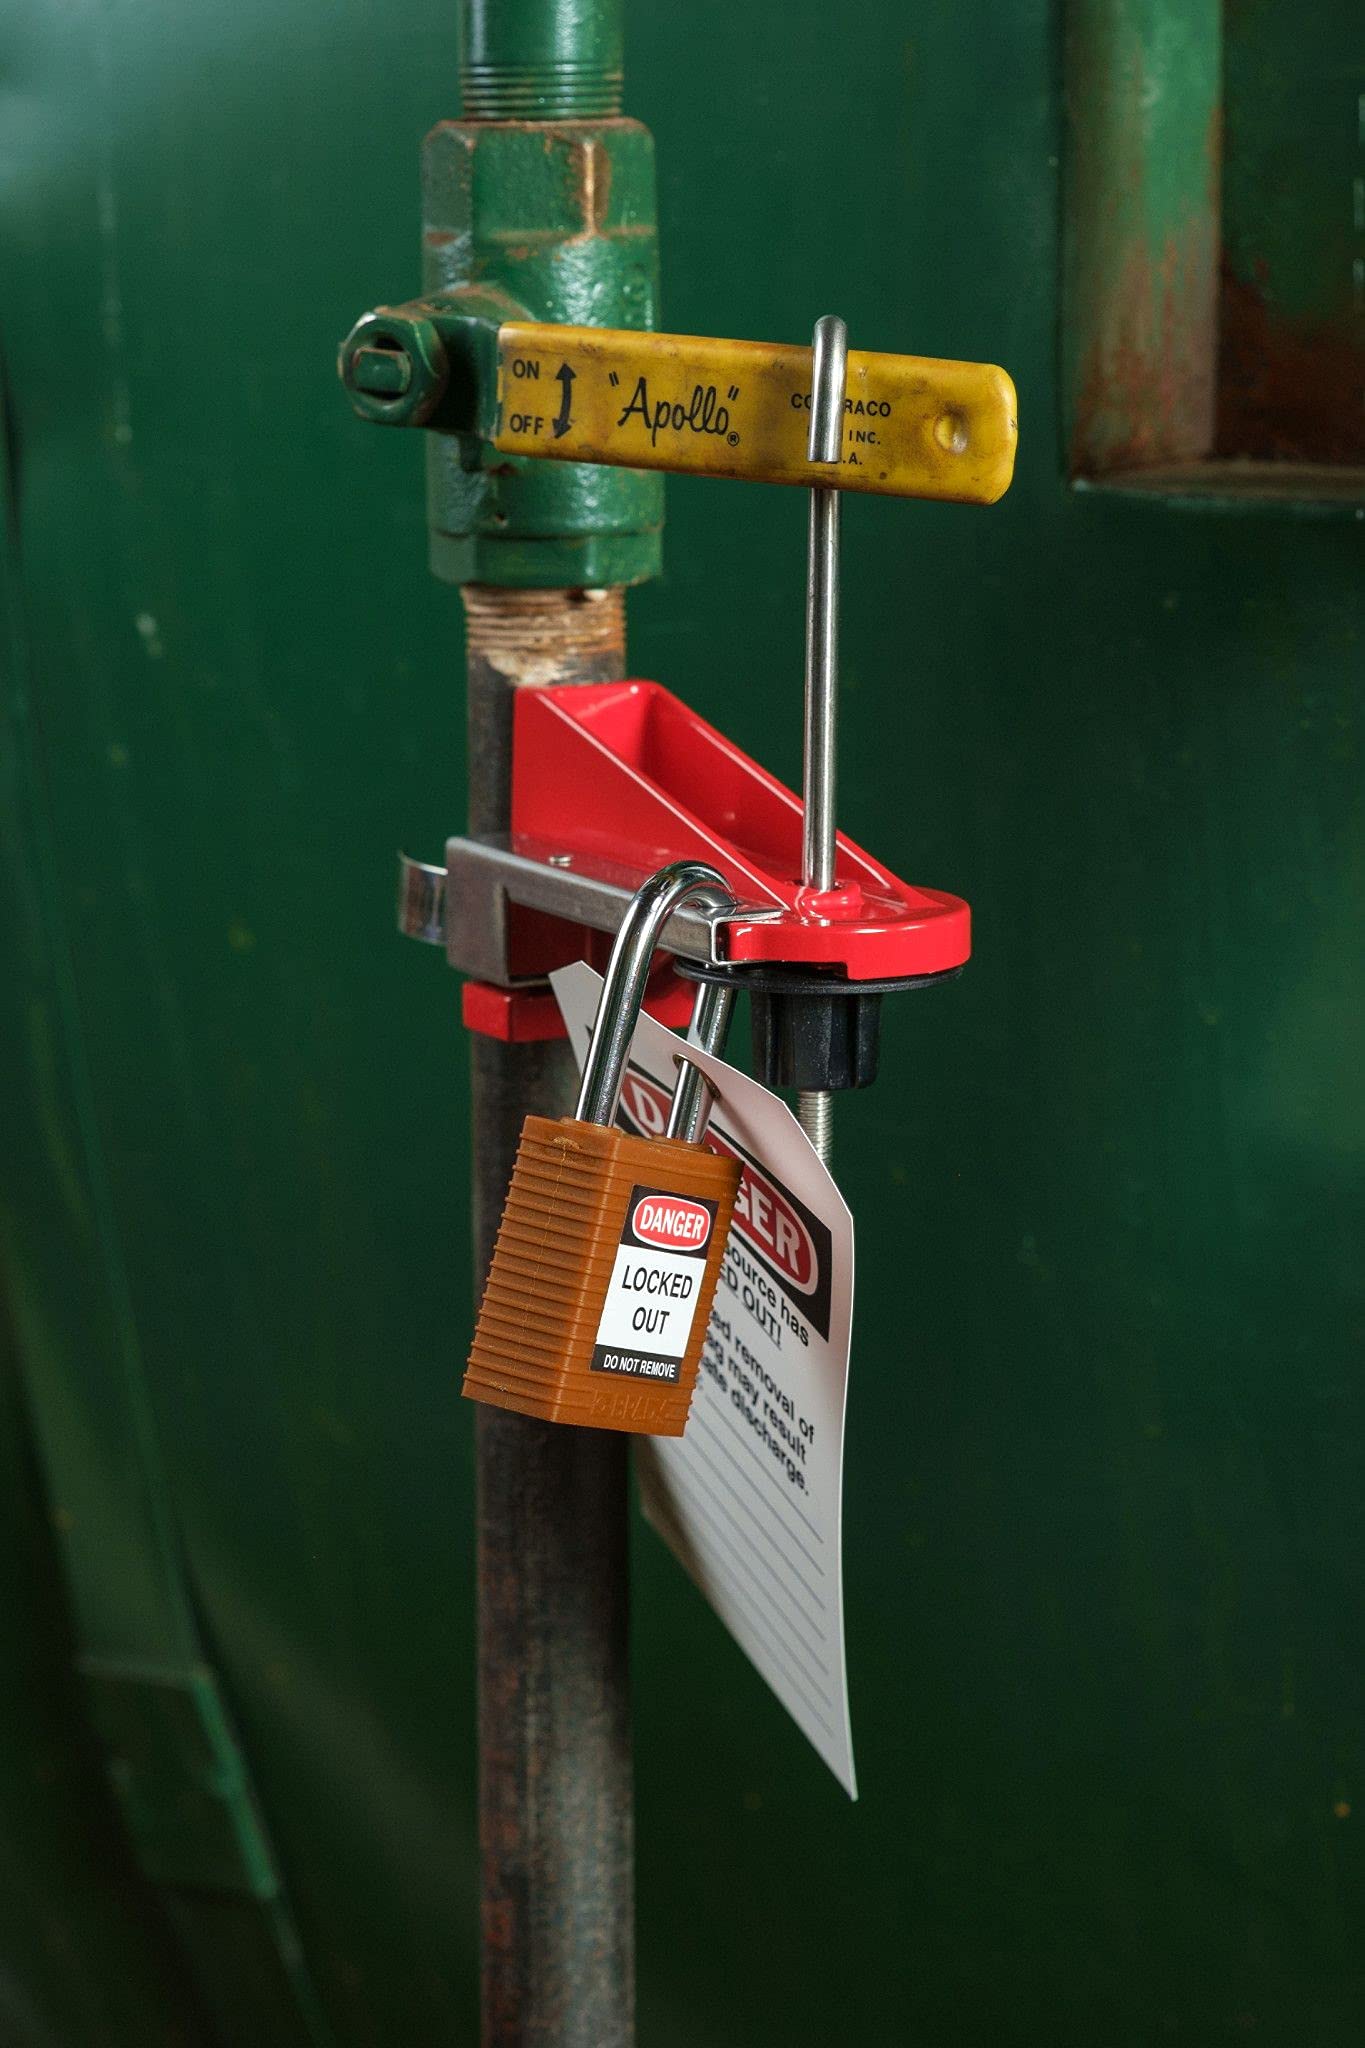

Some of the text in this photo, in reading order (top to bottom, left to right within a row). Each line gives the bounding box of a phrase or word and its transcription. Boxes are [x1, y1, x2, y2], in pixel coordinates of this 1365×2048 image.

[512, 359, 540, 380] ON
[791, 393, 892, 417] CORACO
[509, 413, 544, 435] OFF
[849, 429, 881, 445] INC.
[640, 1204, 705, 1240] DANGER
[621, 1264, 693, 1299] LOCKED
[631, 1306, 670, 1335] OUT
[743, 1285, 782, 1347] OUT!
[781, 1297, 809, 1347] has
[603, 1354, 676, 1378] DO NOT REMOVE
[734, 1336, 814, 1444] removal of
[728, 1356, 759, 1406] may
[763, 1399, 806, 1465] result
[731, 1389, 809, 1496] discharge.
